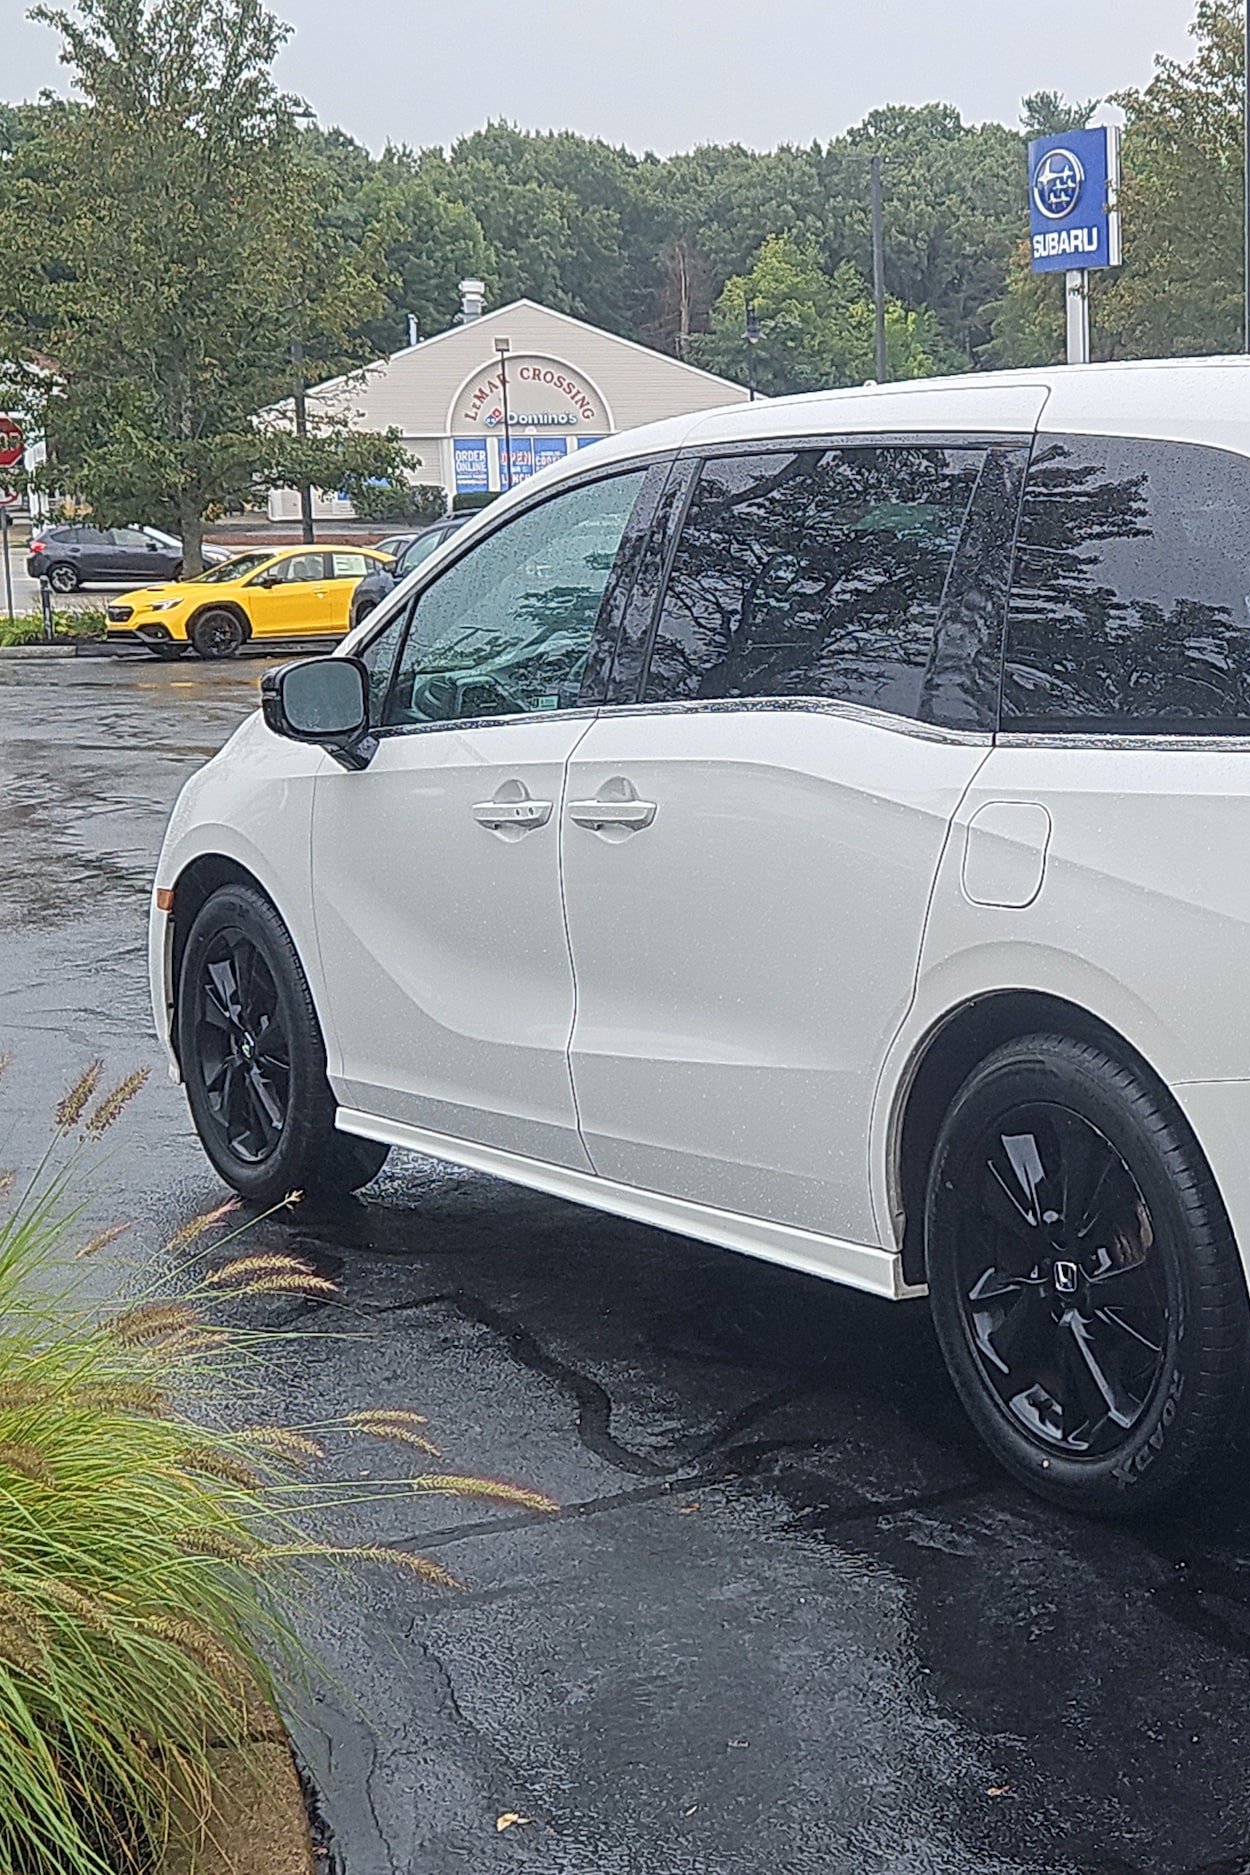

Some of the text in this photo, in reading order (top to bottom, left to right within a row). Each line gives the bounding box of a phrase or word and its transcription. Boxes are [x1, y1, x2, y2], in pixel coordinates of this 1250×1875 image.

[1032, 227, 1098, 258] SUBARU
[520, 367, 595, 420] CROSSING
[507, 410, 578, 425] Domino's
[455, 450, 486, 462] ORDER
[456, 461, 487, 472] ONLINE
